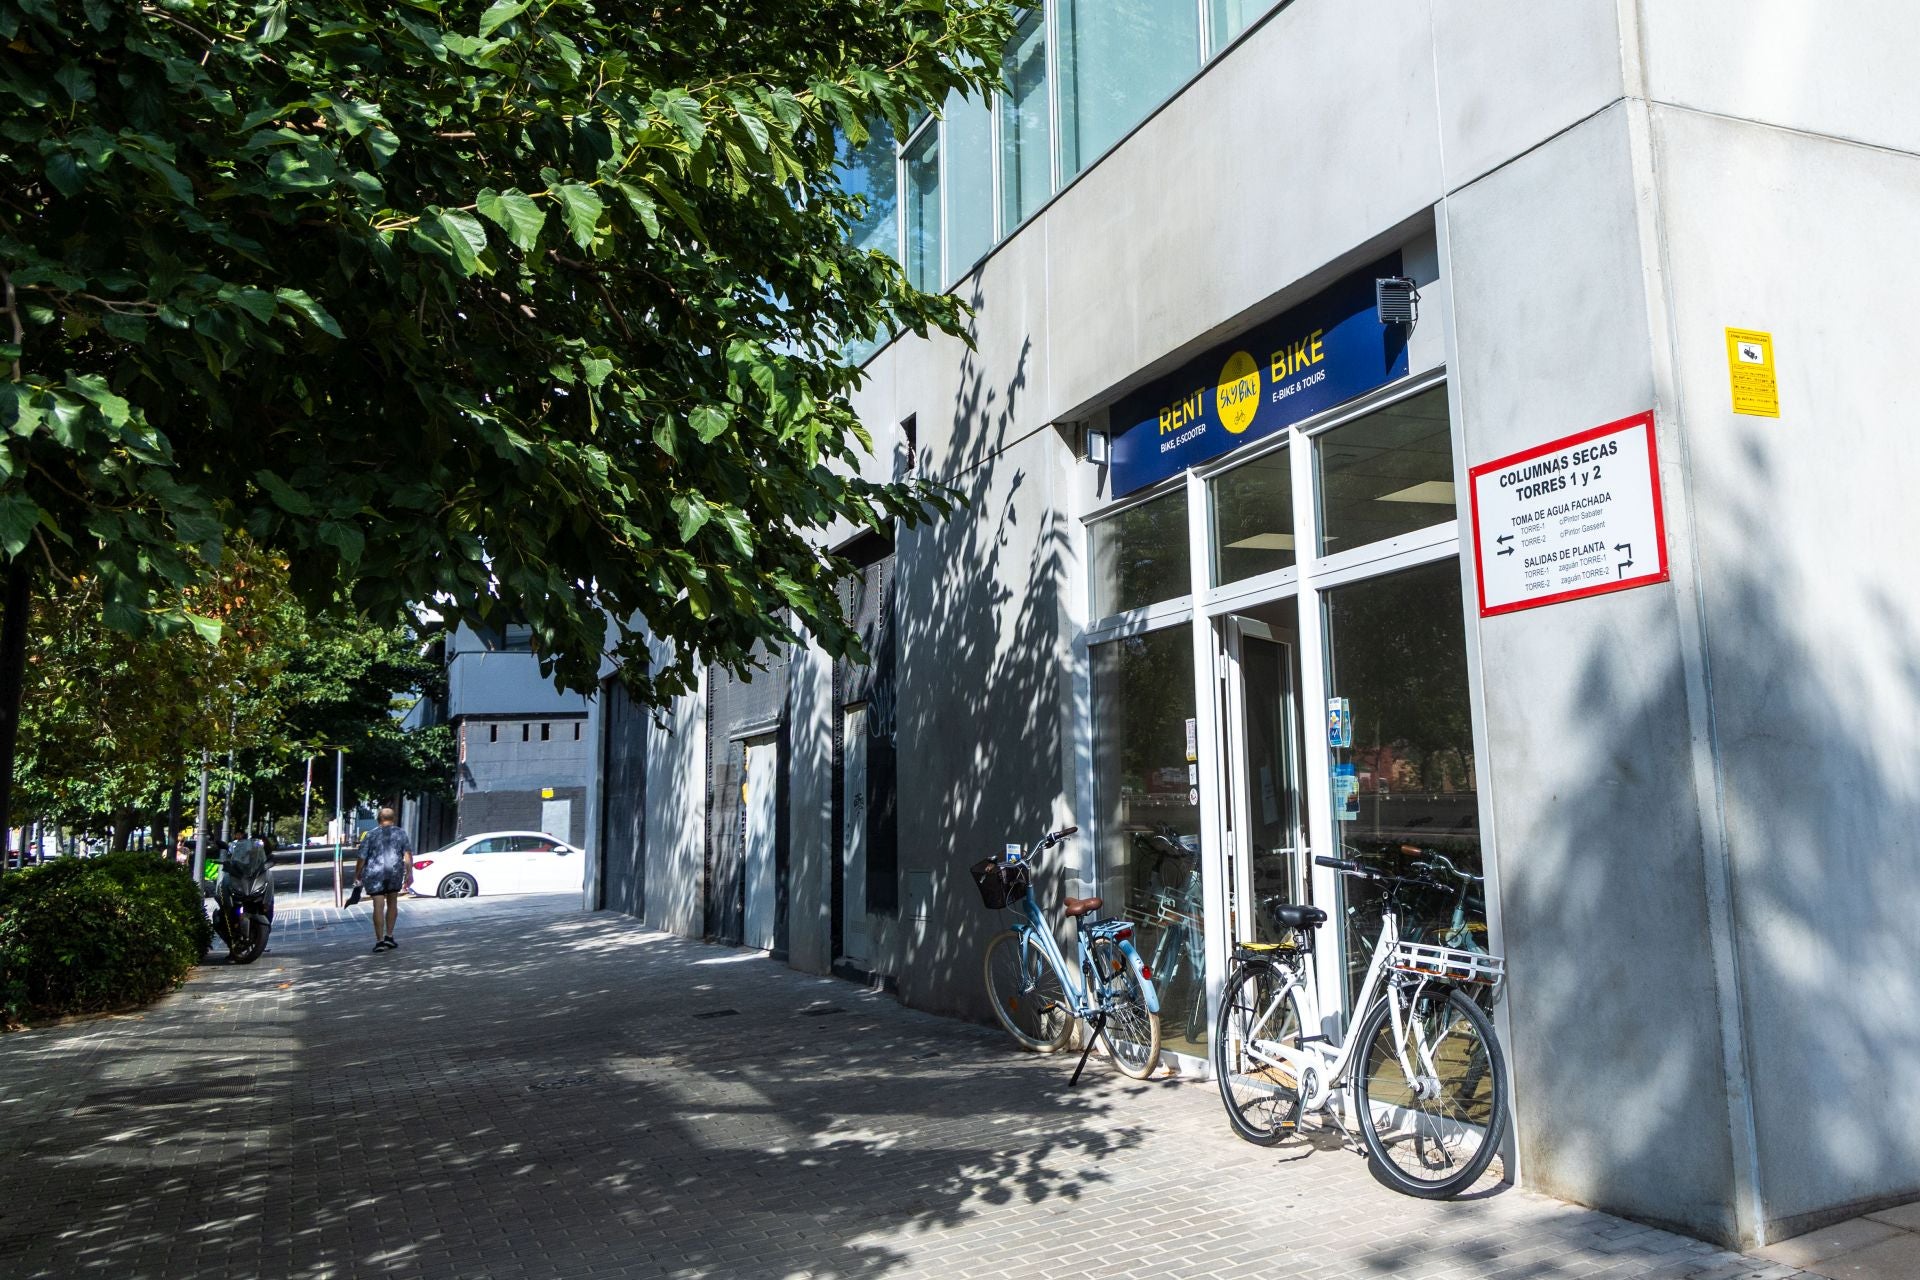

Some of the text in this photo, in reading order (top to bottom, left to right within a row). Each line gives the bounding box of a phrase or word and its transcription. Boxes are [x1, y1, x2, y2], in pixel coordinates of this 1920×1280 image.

[1271, 328, 1324, 383] BIKE
[1272, 369, 1326, 403] E-BIKE & TOURS
[1159, 386, 1206, 436] RENT
[1176, 423, 1206, 447] E-SCOOTER
[1499, 440, 1618, 488] COLUMNAS SECAS
[1516, 465, 1602, 501] TORRES 1 y 2
[1511, 492, 1612, 527] TOMA DE AGUA FACHADA
[1520, 522, 1545, 535] TORRE-1
[1521, 535, 1547, 548] TORRE-2
[1524, 541, 1606, 568] SALIDAS DE PLANTA
[1525, 567, 1550, 579] TORRE-1
[1580, 554, 1607, 567] TORRE-1
[1525, 580, 1551, 591] TORRE-2
[1582, 567, 1610, 580] TORRE-2
